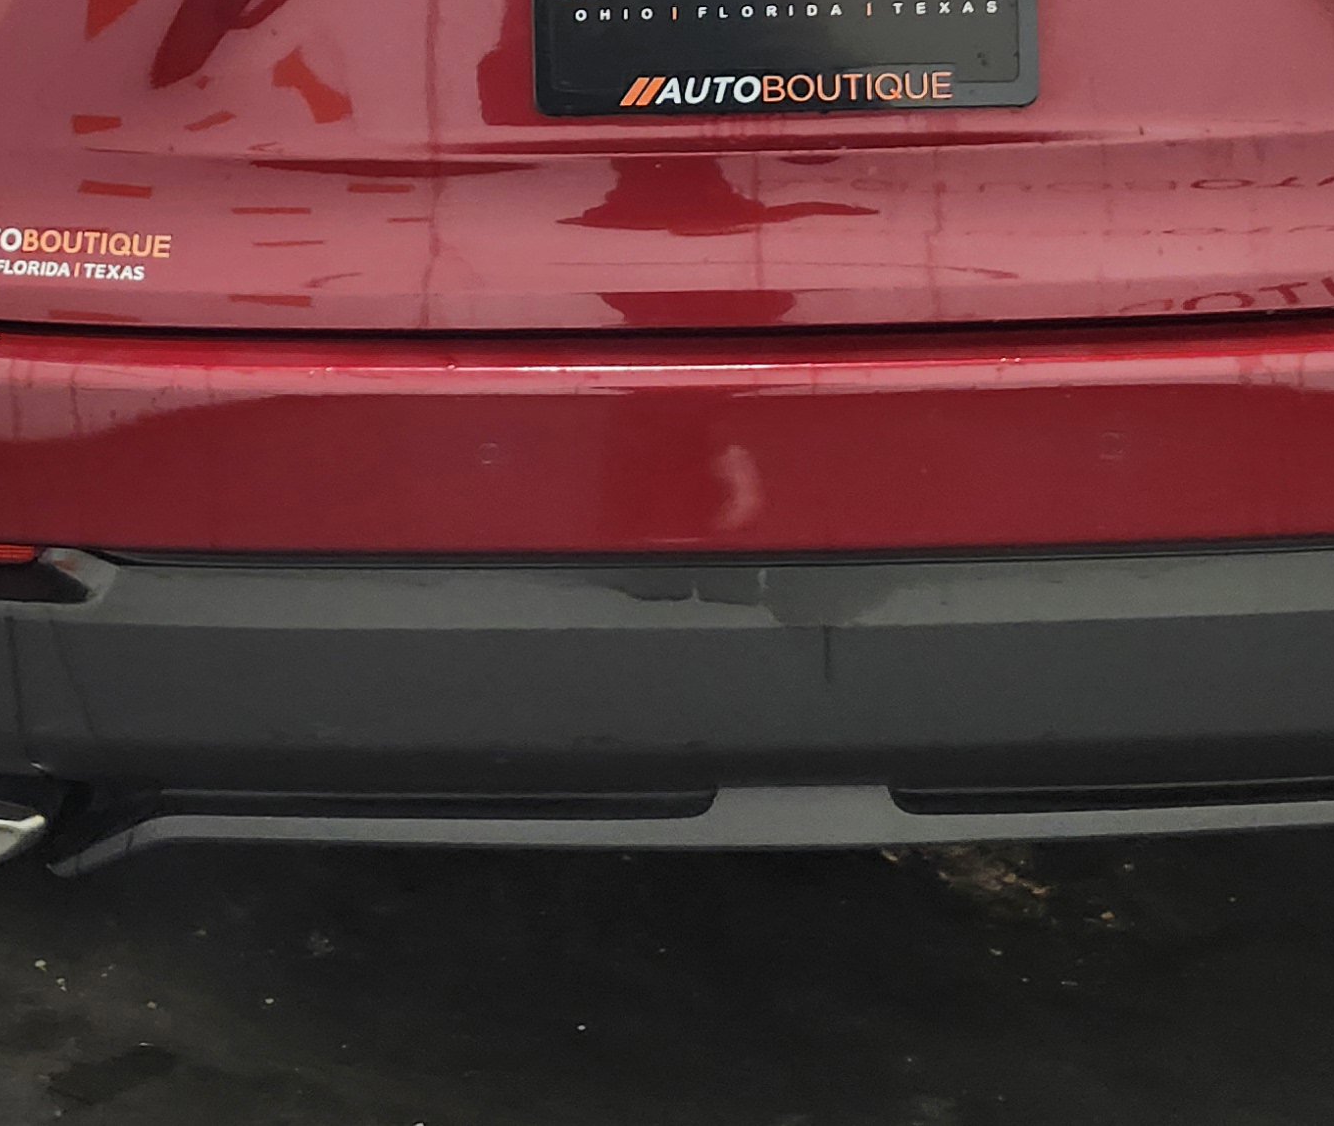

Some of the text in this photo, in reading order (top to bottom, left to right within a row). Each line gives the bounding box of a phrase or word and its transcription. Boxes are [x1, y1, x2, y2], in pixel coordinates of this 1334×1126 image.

[575, 7, 654, 22] OHIO
[697, 5, 843, 19] FLORIDA
[893, 1, 999, 16] TEXAS
[83, 263, 145, 282] TEXAS
